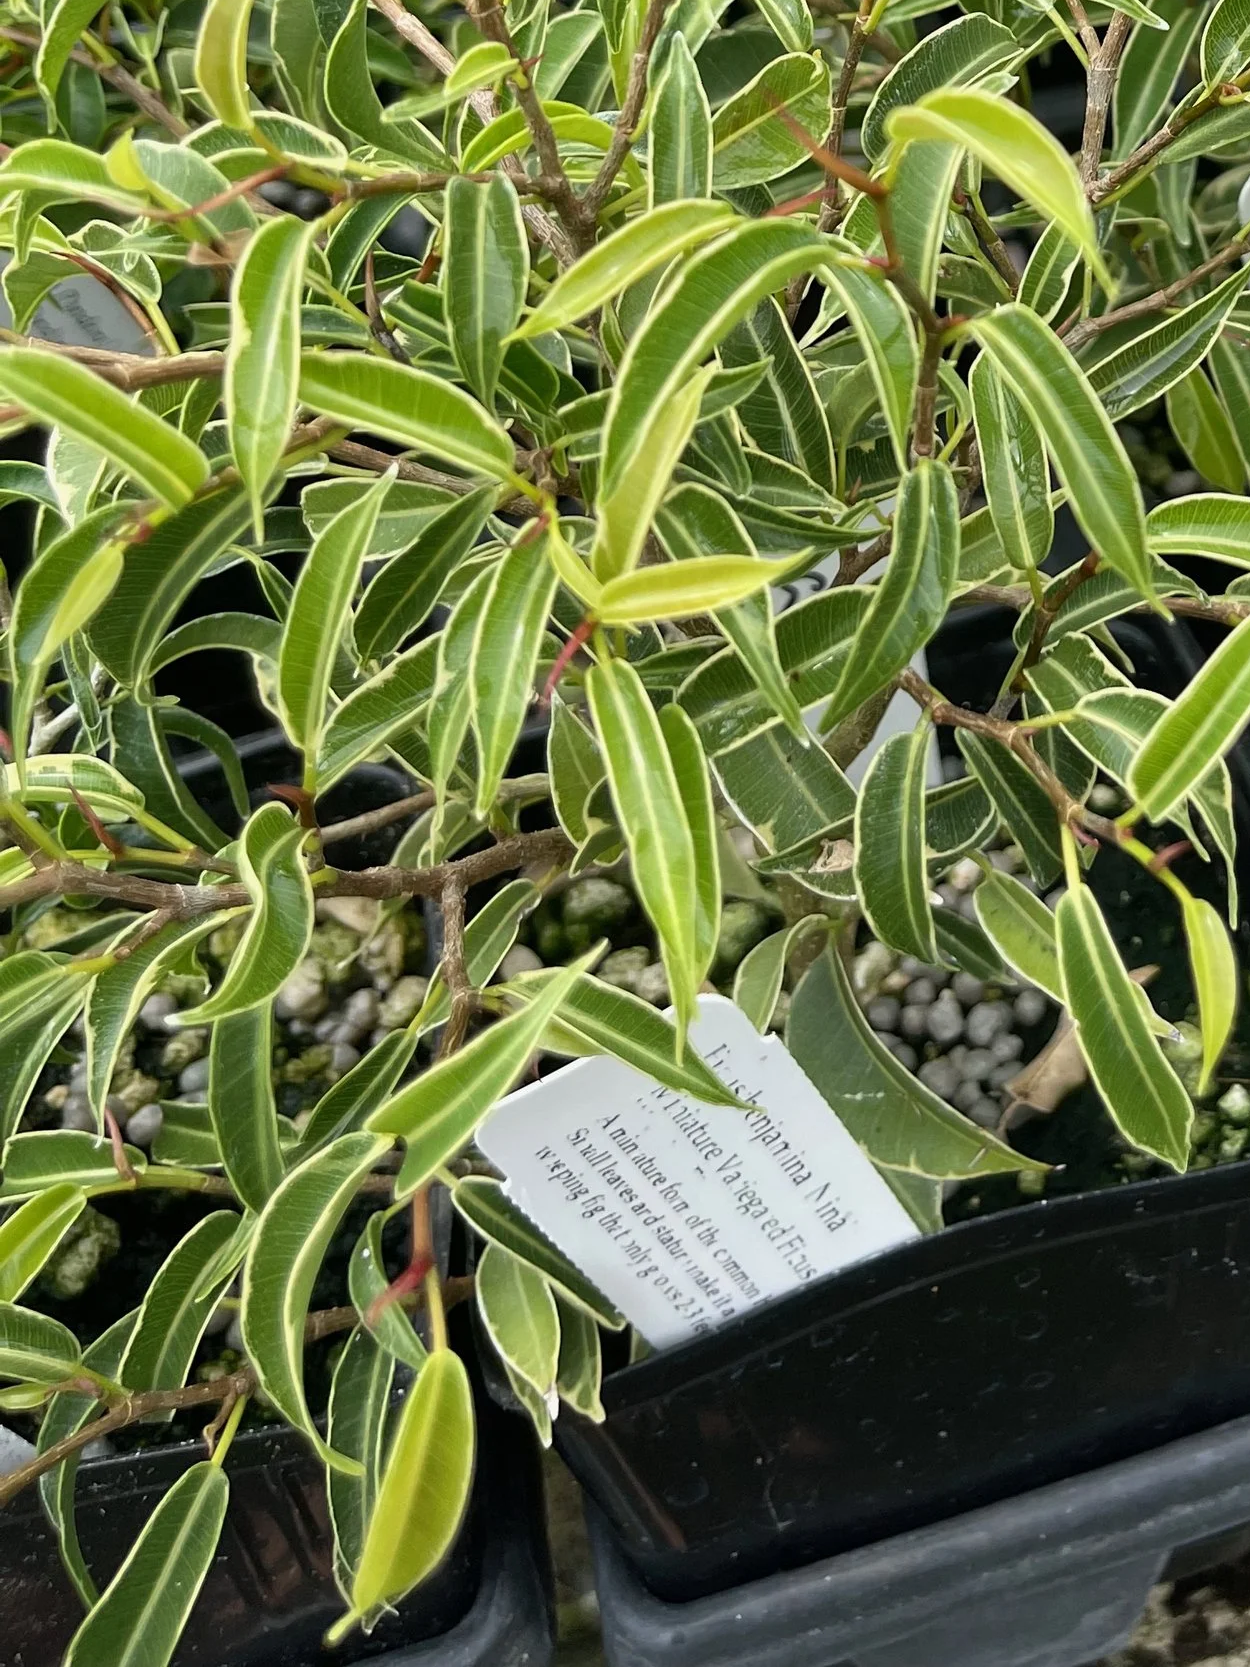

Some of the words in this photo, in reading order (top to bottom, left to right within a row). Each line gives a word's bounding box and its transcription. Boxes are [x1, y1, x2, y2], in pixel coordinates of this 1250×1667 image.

[580, 1194, 607, 1220] fig
[595, 1113, 621, 1130] A
[684, 1212, 714, 1230] of
[597, 1159, 640, 1206] leaves
[719, 1304, 737, 1319] a
